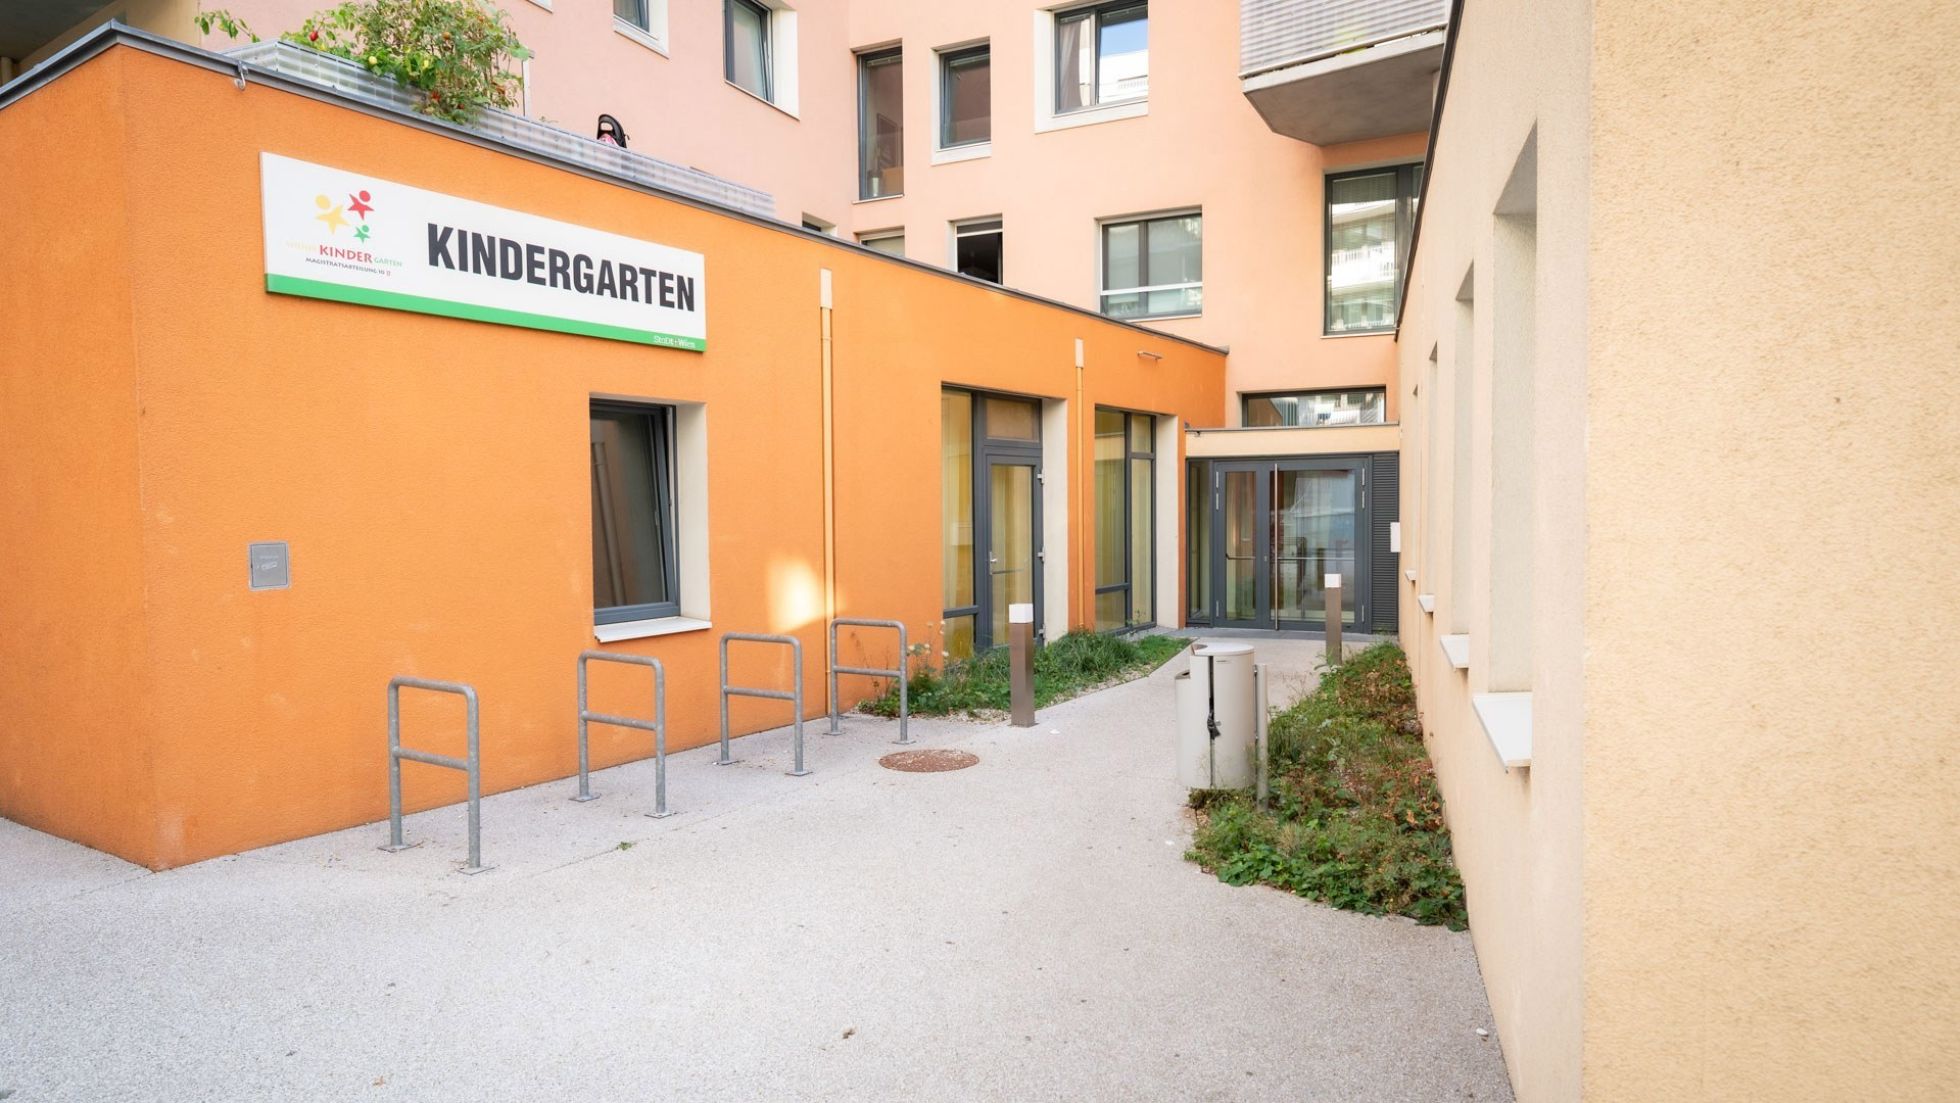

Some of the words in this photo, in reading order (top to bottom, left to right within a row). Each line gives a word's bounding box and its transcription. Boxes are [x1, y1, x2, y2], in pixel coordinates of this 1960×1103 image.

[319, 244, 373, 263] KINDER
[374, 256, 403, 267] GARTEN
[428, 223, 695, 312] KINDERGARTEN
